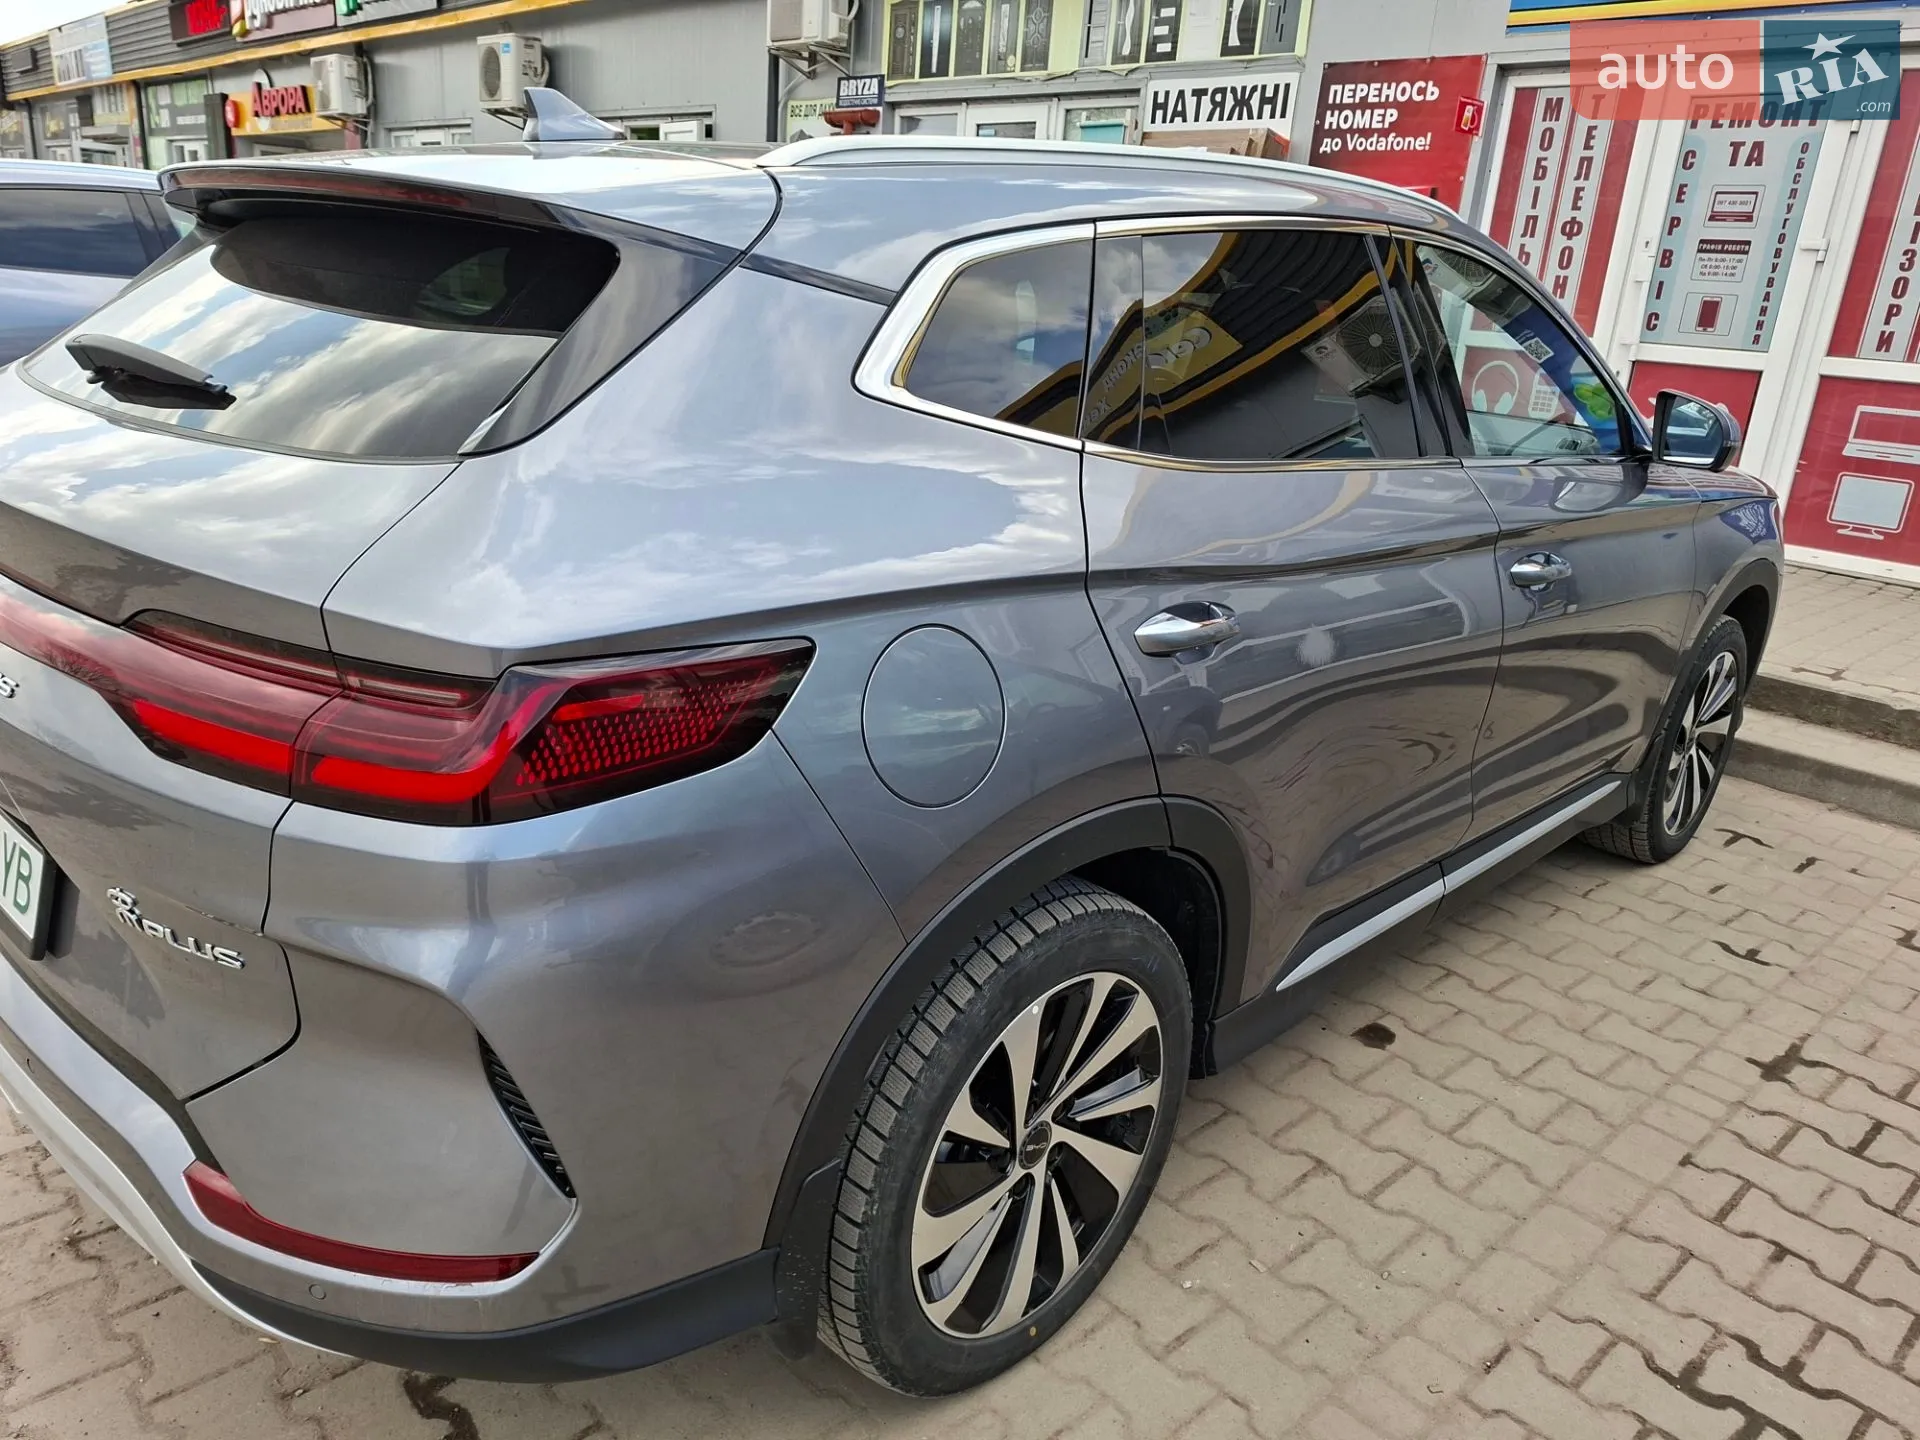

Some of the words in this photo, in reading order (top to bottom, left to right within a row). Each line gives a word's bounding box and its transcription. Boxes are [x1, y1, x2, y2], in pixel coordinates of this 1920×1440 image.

[840, 78, 878, 96] BRYZA
[1328, 81, 1440, 104] ПЕРЕНОСЬ
[1150, 82, 1291, 124] НАТЯЖНІ
[1690, 100, 1827, 129] РЕМОНТ
[1324, 108, 1398, 129] НОМЕР
[1319, 138, 1342, 154] до
[1346, 132, 1432, 151] Vodafone!
[1728, 141, 1764, 167] ТА
[1645, 149, 1697, 332] СЕРВІС
[1865, 193, 1920, 353] ІЗОРИ
[142, 918, 245, 969] PLUS
